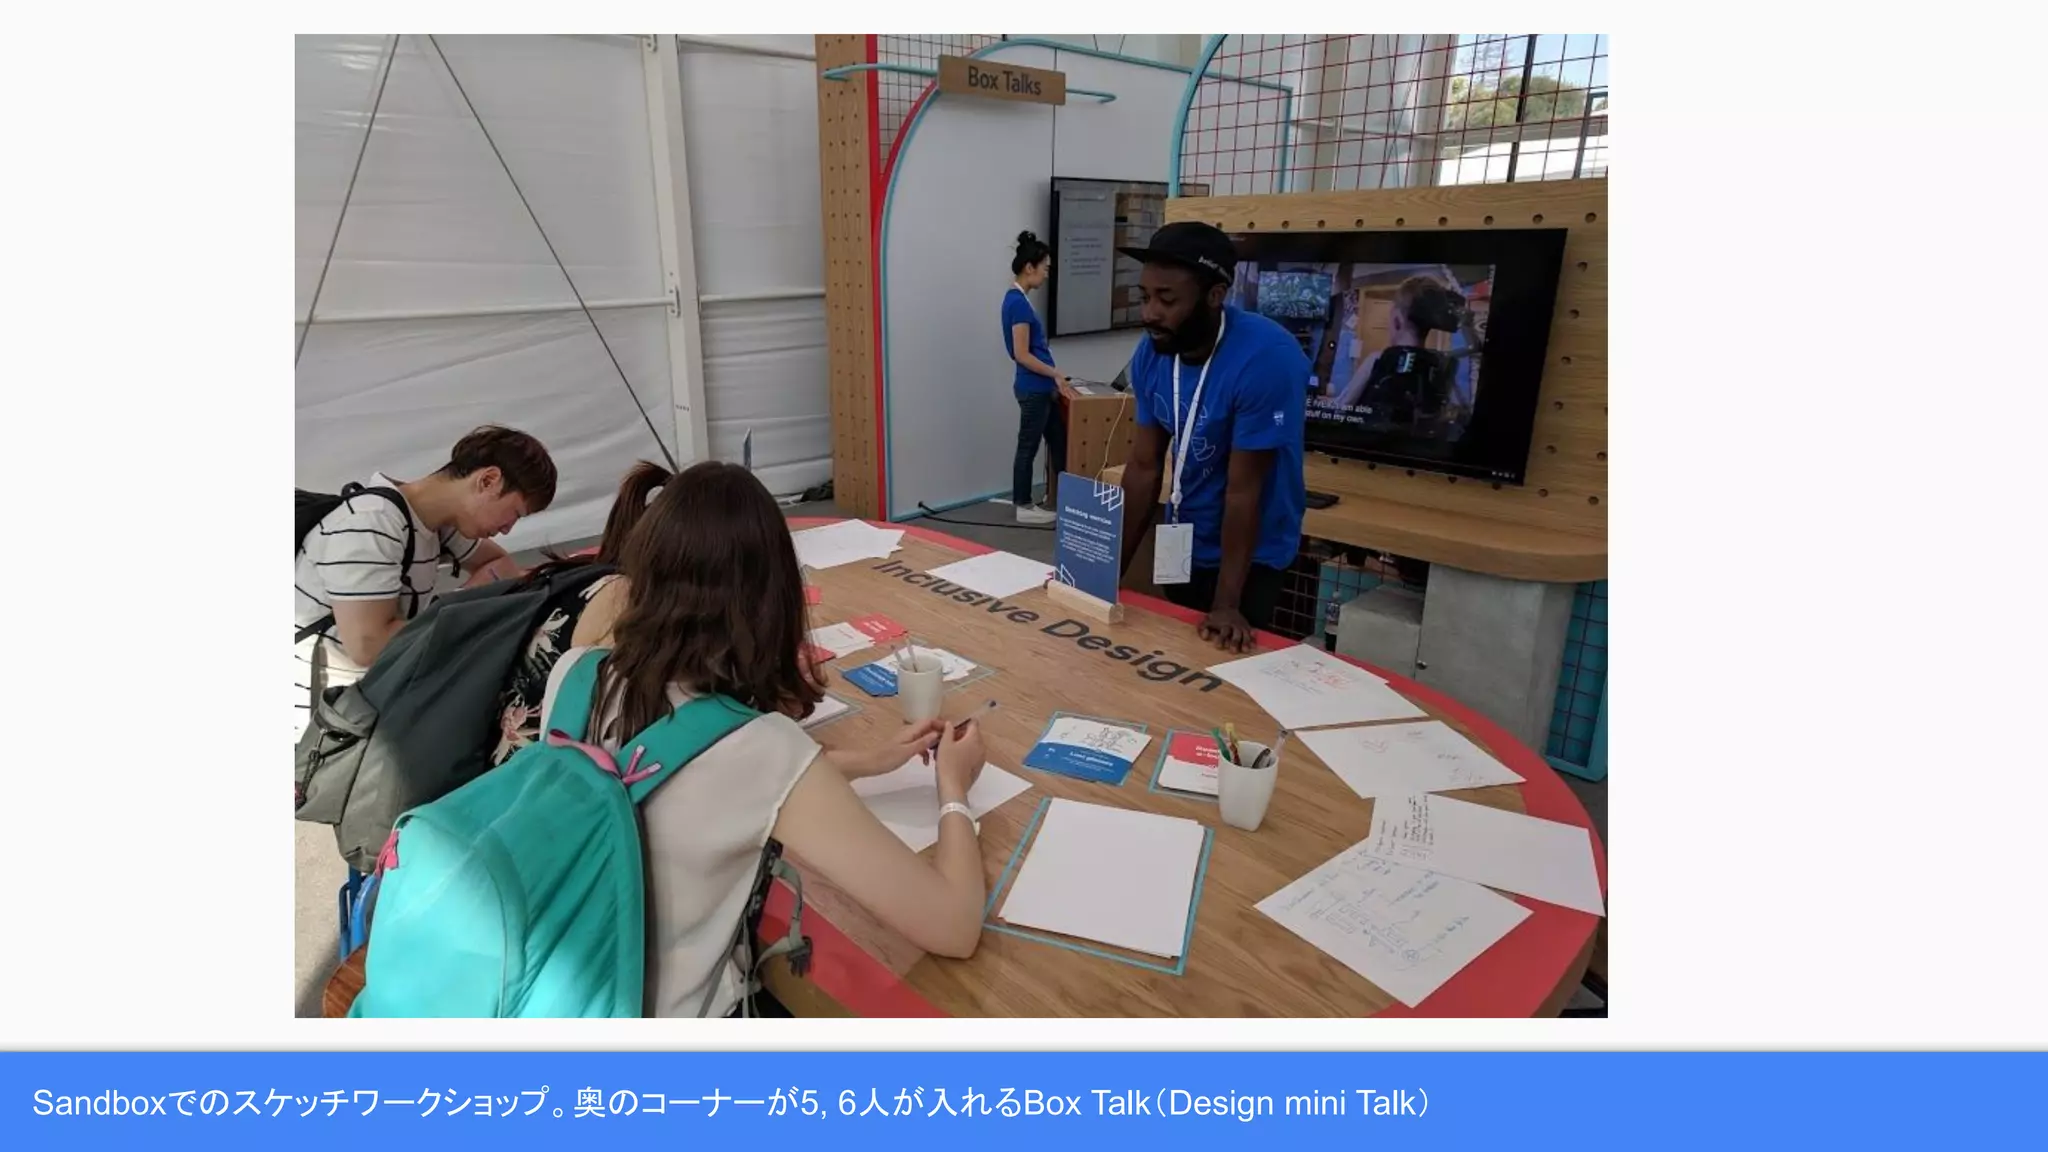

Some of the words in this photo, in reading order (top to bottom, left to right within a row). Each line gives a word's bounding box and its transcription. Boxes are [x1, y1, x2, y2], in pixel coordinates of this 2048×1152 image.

[967, 65, 1000, 91] Box
[1002, 70, 1042, 96] Talks
[1321, 411, 1332, 420] on
[872, 559, 1041, 624] Inclusive
[1040, 618, 1224, 693] Design
